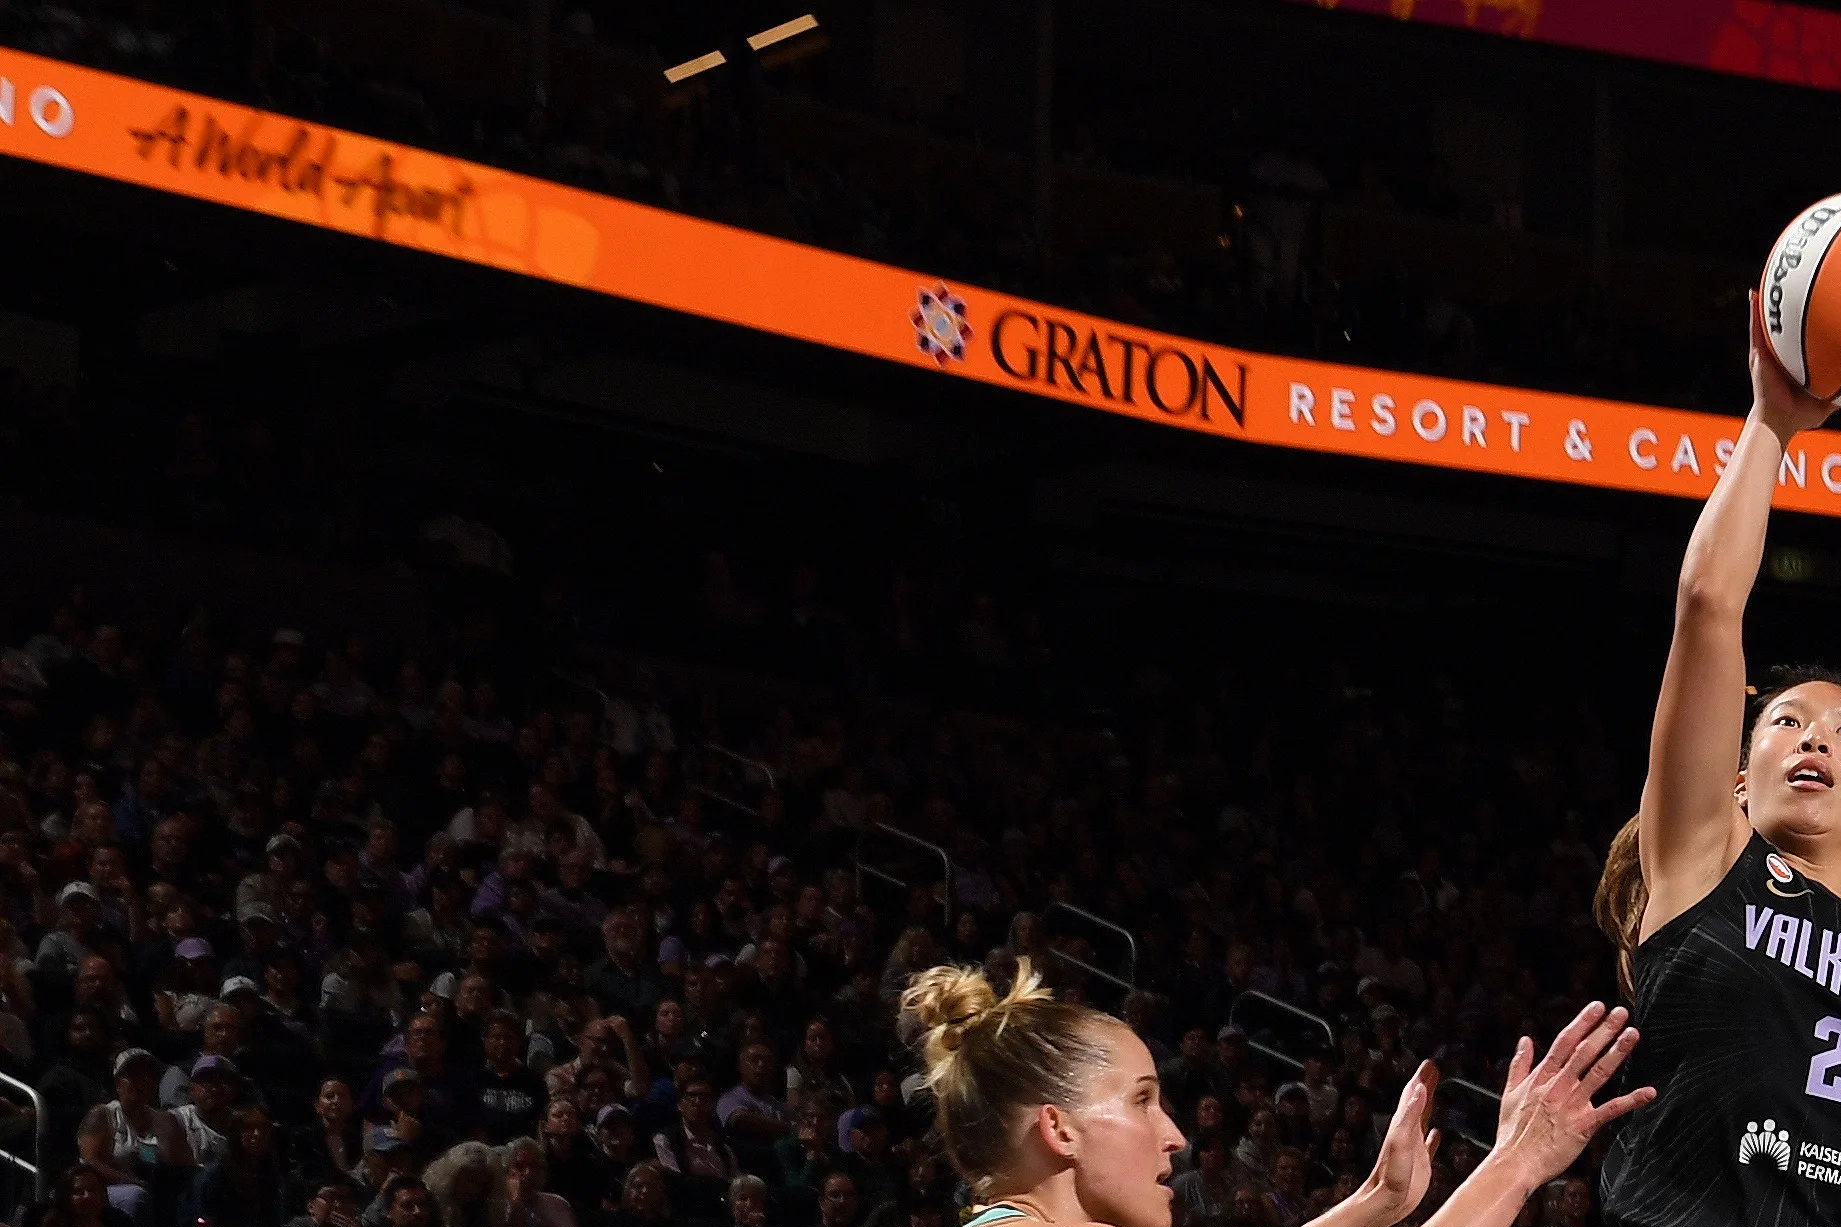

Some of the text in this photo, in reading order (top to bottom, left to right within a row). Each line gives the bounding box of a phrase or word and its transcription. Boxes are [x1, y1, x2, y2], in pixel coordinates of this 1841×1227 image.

[129, 106, 188, 168] A
[195, 111, 335, 196] World
[1768, 207, 1841, 335] Wilson
[990, 306, 1250, 429] GRATON
[1289, 381, 1531, 454] RESORT
[1563, 418, 1594, 463] &
